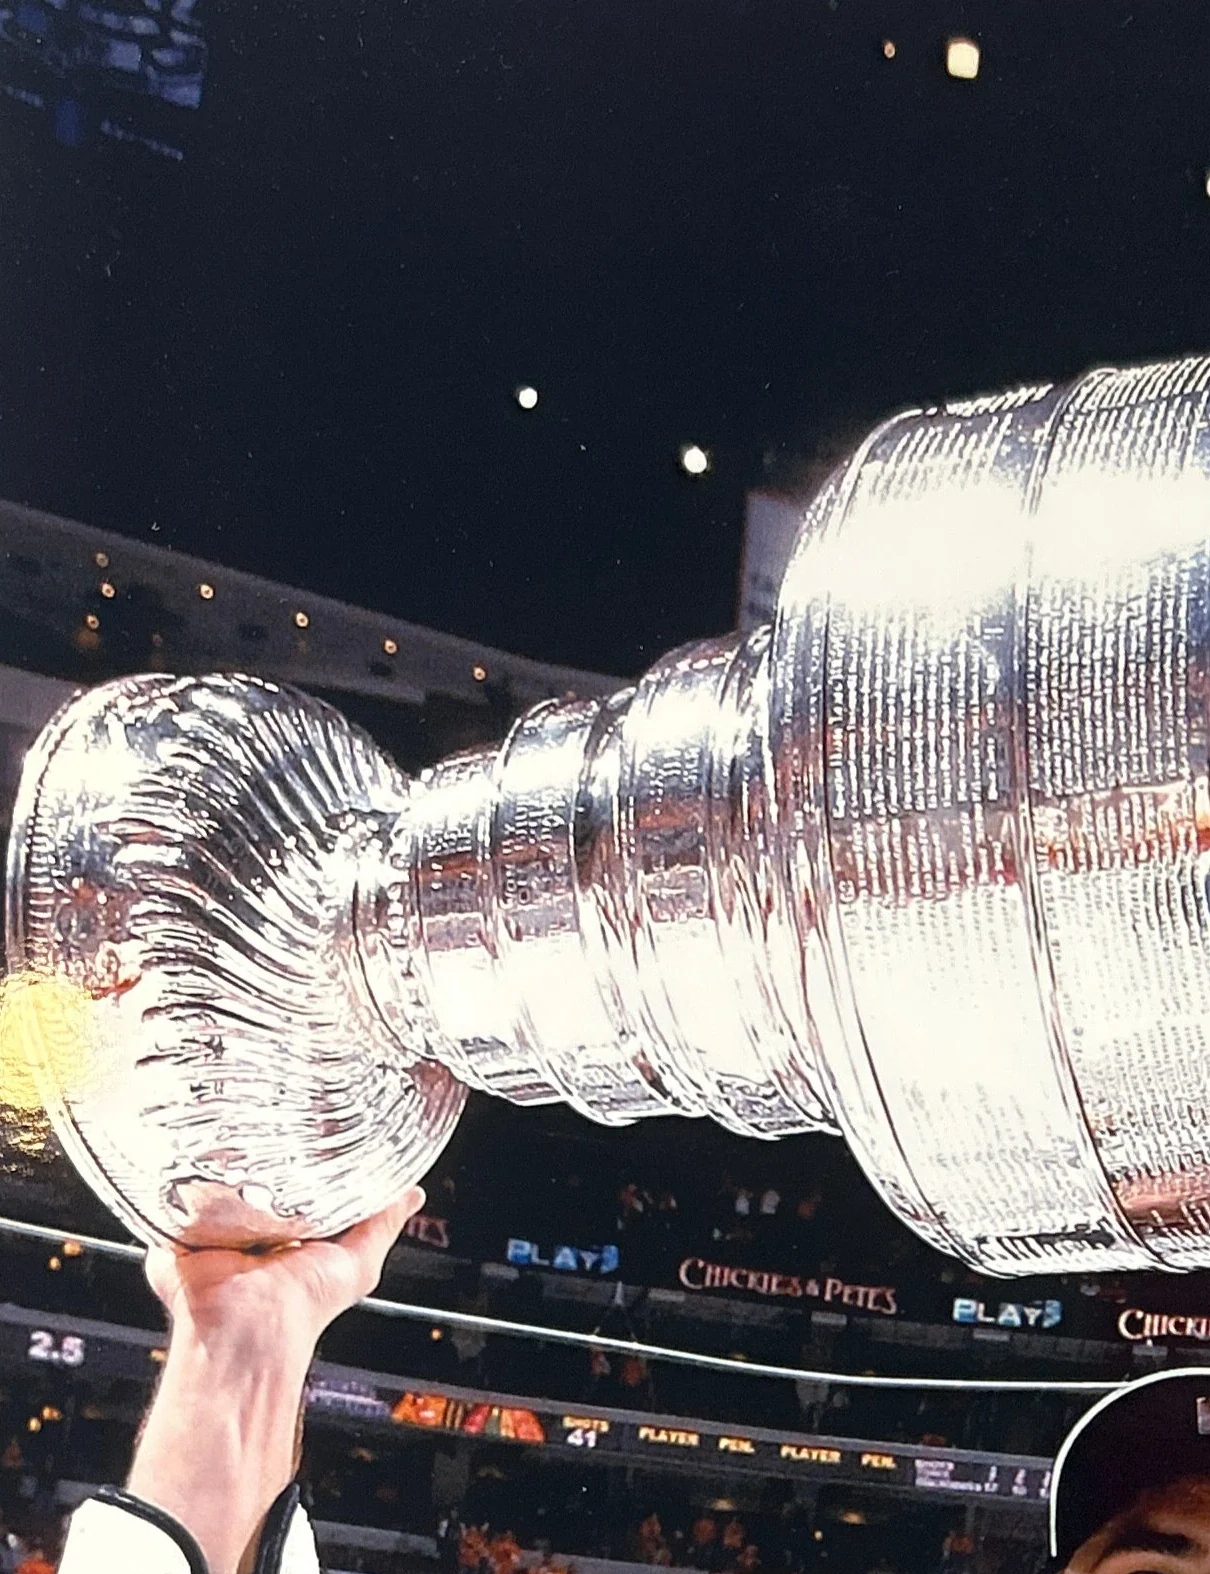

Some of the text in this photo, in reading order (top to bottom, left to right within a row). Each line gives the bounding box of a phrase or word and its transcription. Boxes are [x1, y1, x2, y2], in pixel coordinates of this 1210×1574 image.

[567, 1428, 597, 1448] 41
[638, 1426, 699, 1447] PLAYER
[780, 1445, 842, 1465] PLAYER
